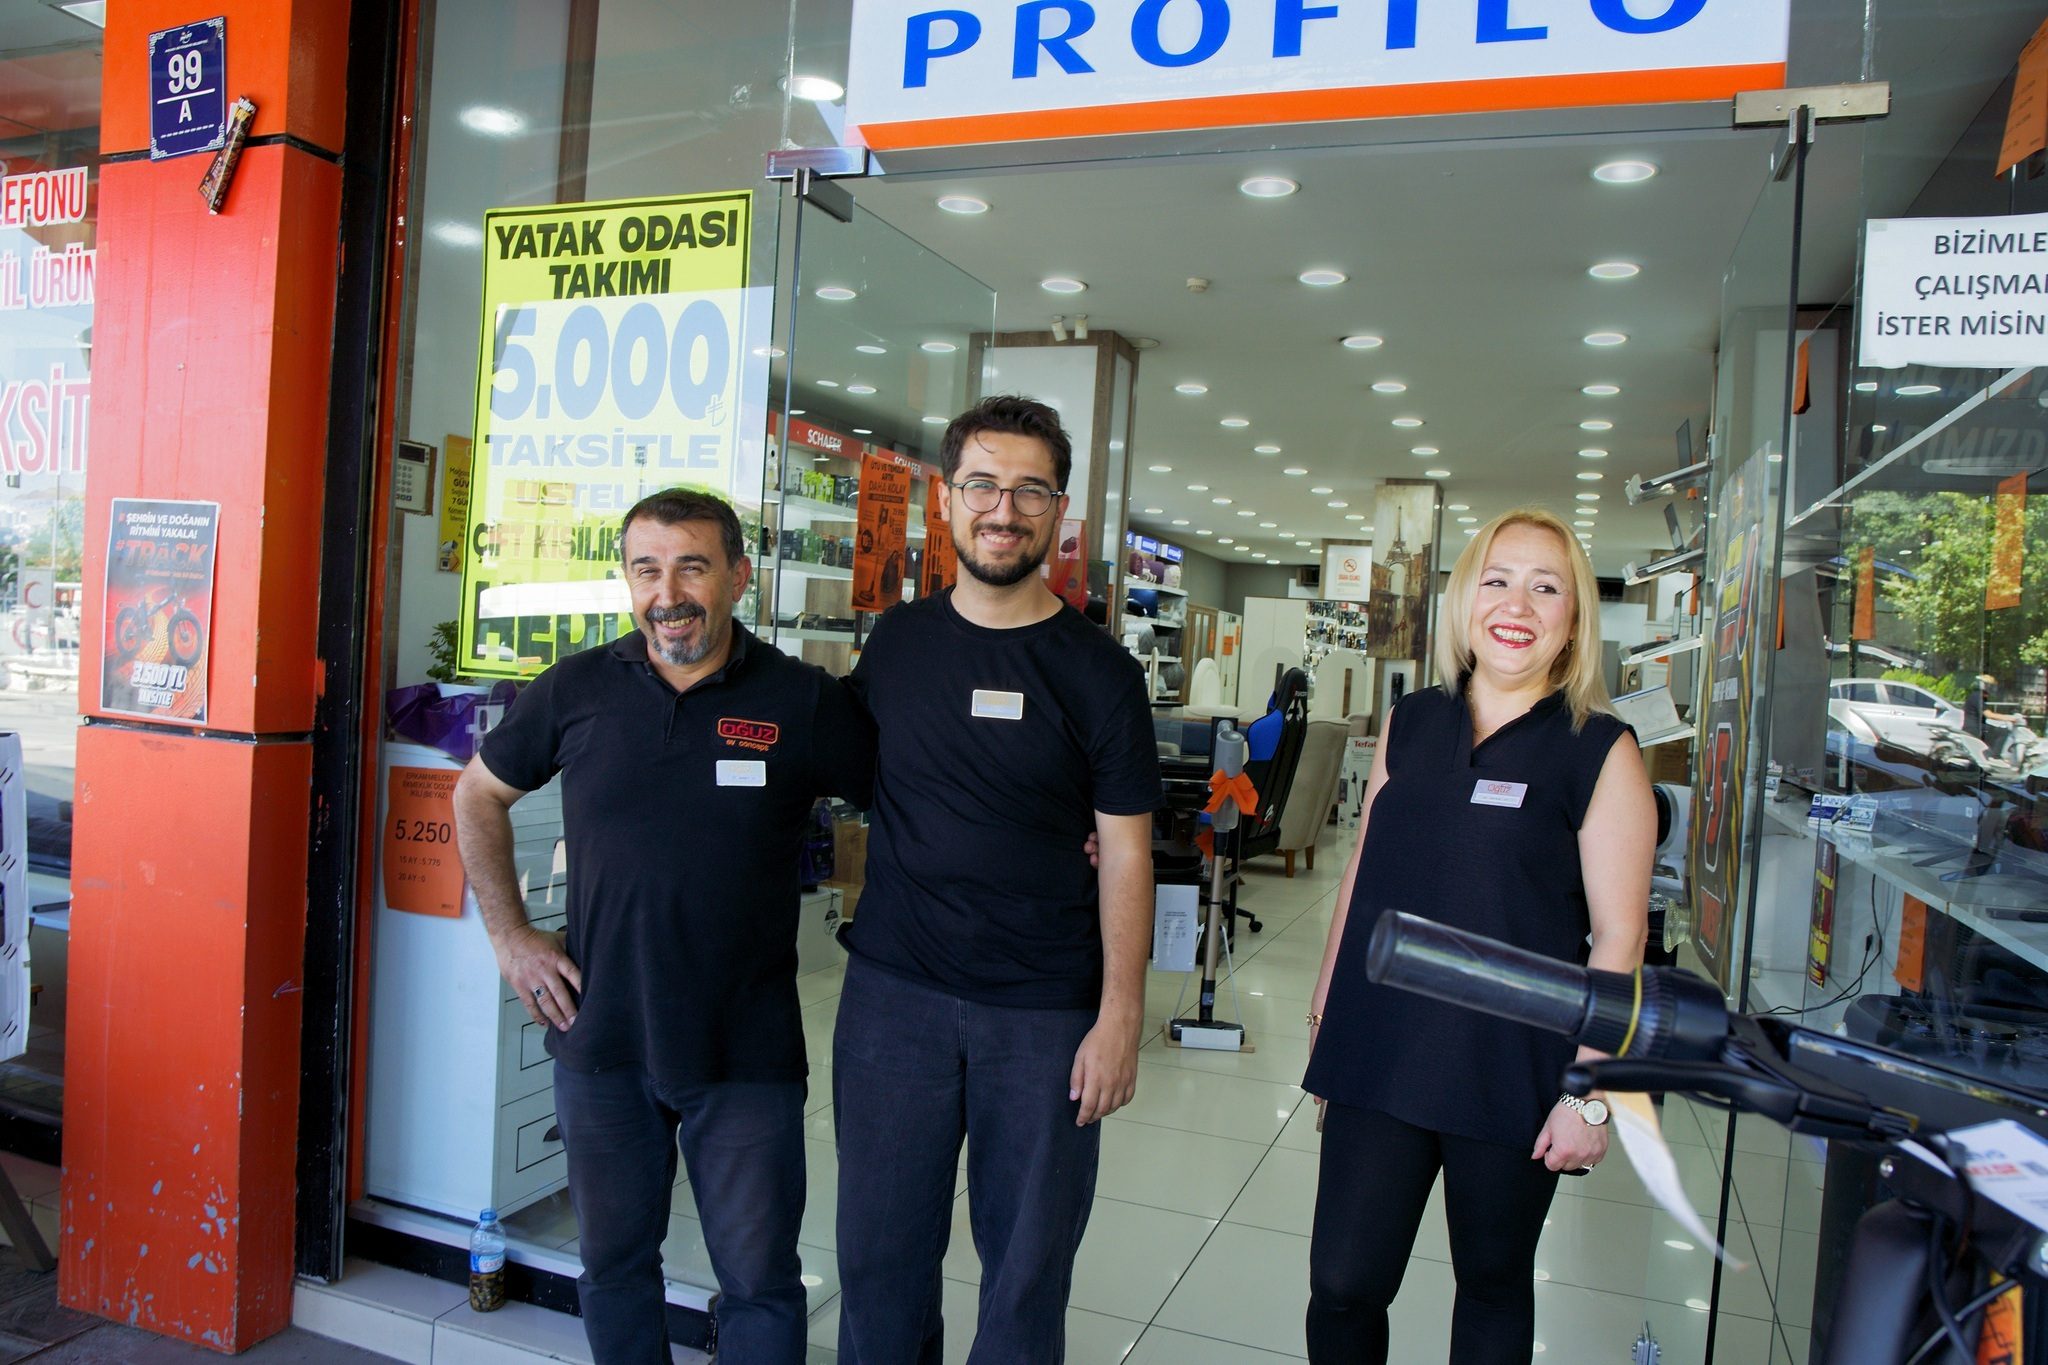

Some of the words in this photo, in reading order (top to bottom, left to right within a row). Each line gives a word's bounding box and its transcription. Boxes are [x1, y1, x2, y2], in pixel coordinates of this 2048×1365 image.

[168, 50, 203, 94] 99
[178, 100, 193, 123] A
[0, 172, 85, 225] EFONU
[495, 219, 607, 260] YATAK
[619, 209, 738, 253] ODASI
[1934, 229, 2048, 255] BİZİMLE
[0, 253, 25, 306] İL
[549, 258, 671, 300] TAKIMI
[1915, 274, 2048, 300] ÇALIŞMA
[1877, 312, 1951, 336] İSTER
[1960, 310, 2044, 336] MİSİN
[490, 300, 730, 421] 5.000
[485, 428, 721, 468] TAKSİTLE
[807, 429, 842, 453] SCHAFER
[126, 511, 156, 526] ŞEHRİN
[158, 514, 168, 524] VE
[169, 513, 210, 527] DOĞANIN
[161, 527, 198, 540] YAKALA!
[722, 721, 775, 740] OĞUZ
[395, 820, 451, 844] 5.250
